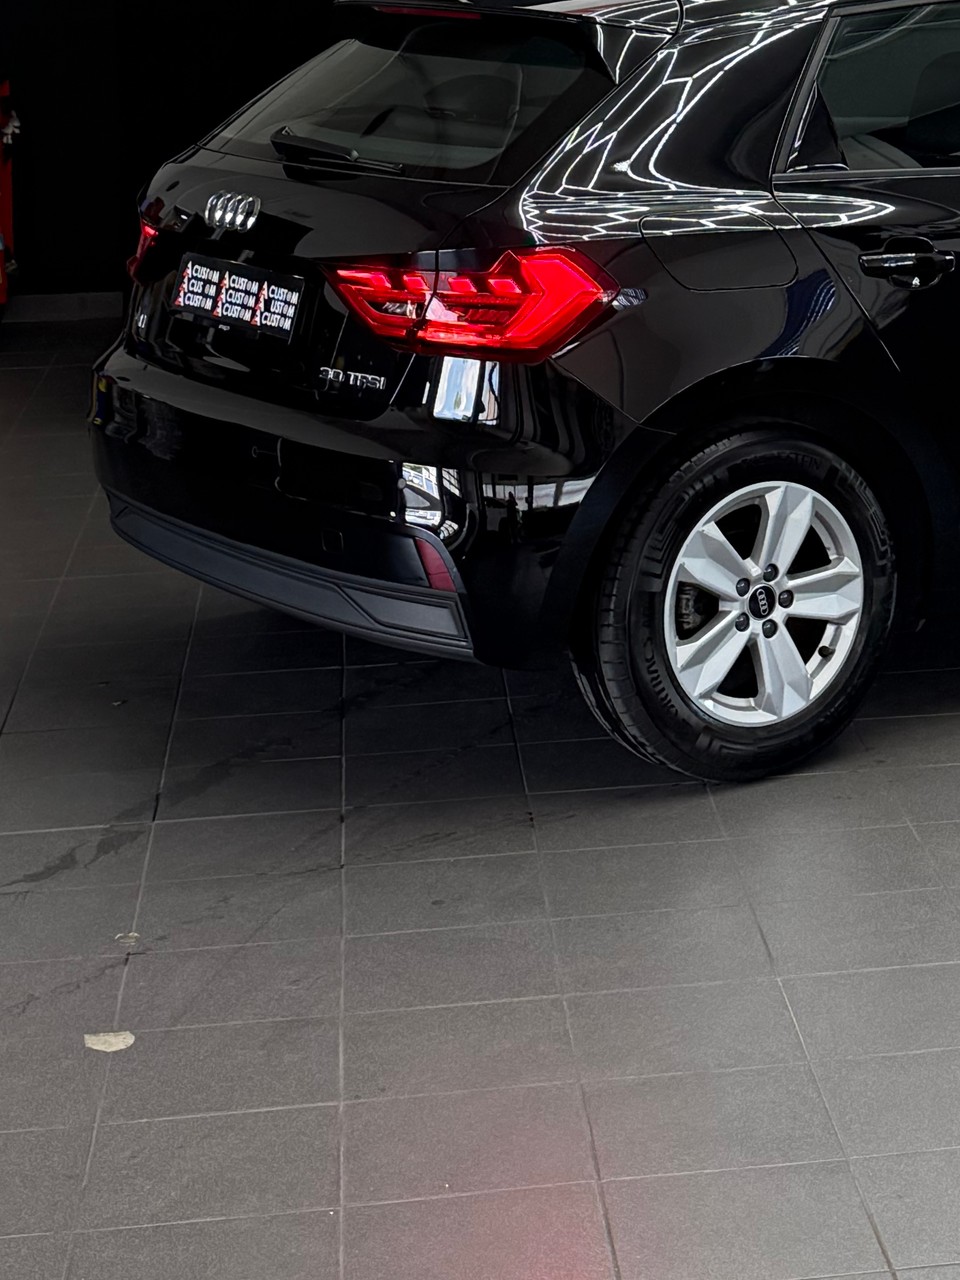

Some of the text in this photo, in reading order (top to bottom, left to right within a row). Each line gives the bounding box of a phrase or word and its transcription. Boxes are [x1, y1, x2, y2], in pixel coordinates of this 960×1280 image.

[192, 264, 220, 283] CUSTOM
[229, 275, 259, 294] CUSTOM
[268, 285, 299, 304] CUSTOM
[226, 290, 256, 308] CUSTOM
[184, 293, 213, 310] CUSTOM
[222, 303, 252, 322] CUSTOM
[261, 312, 292, 331] CUSTOM
